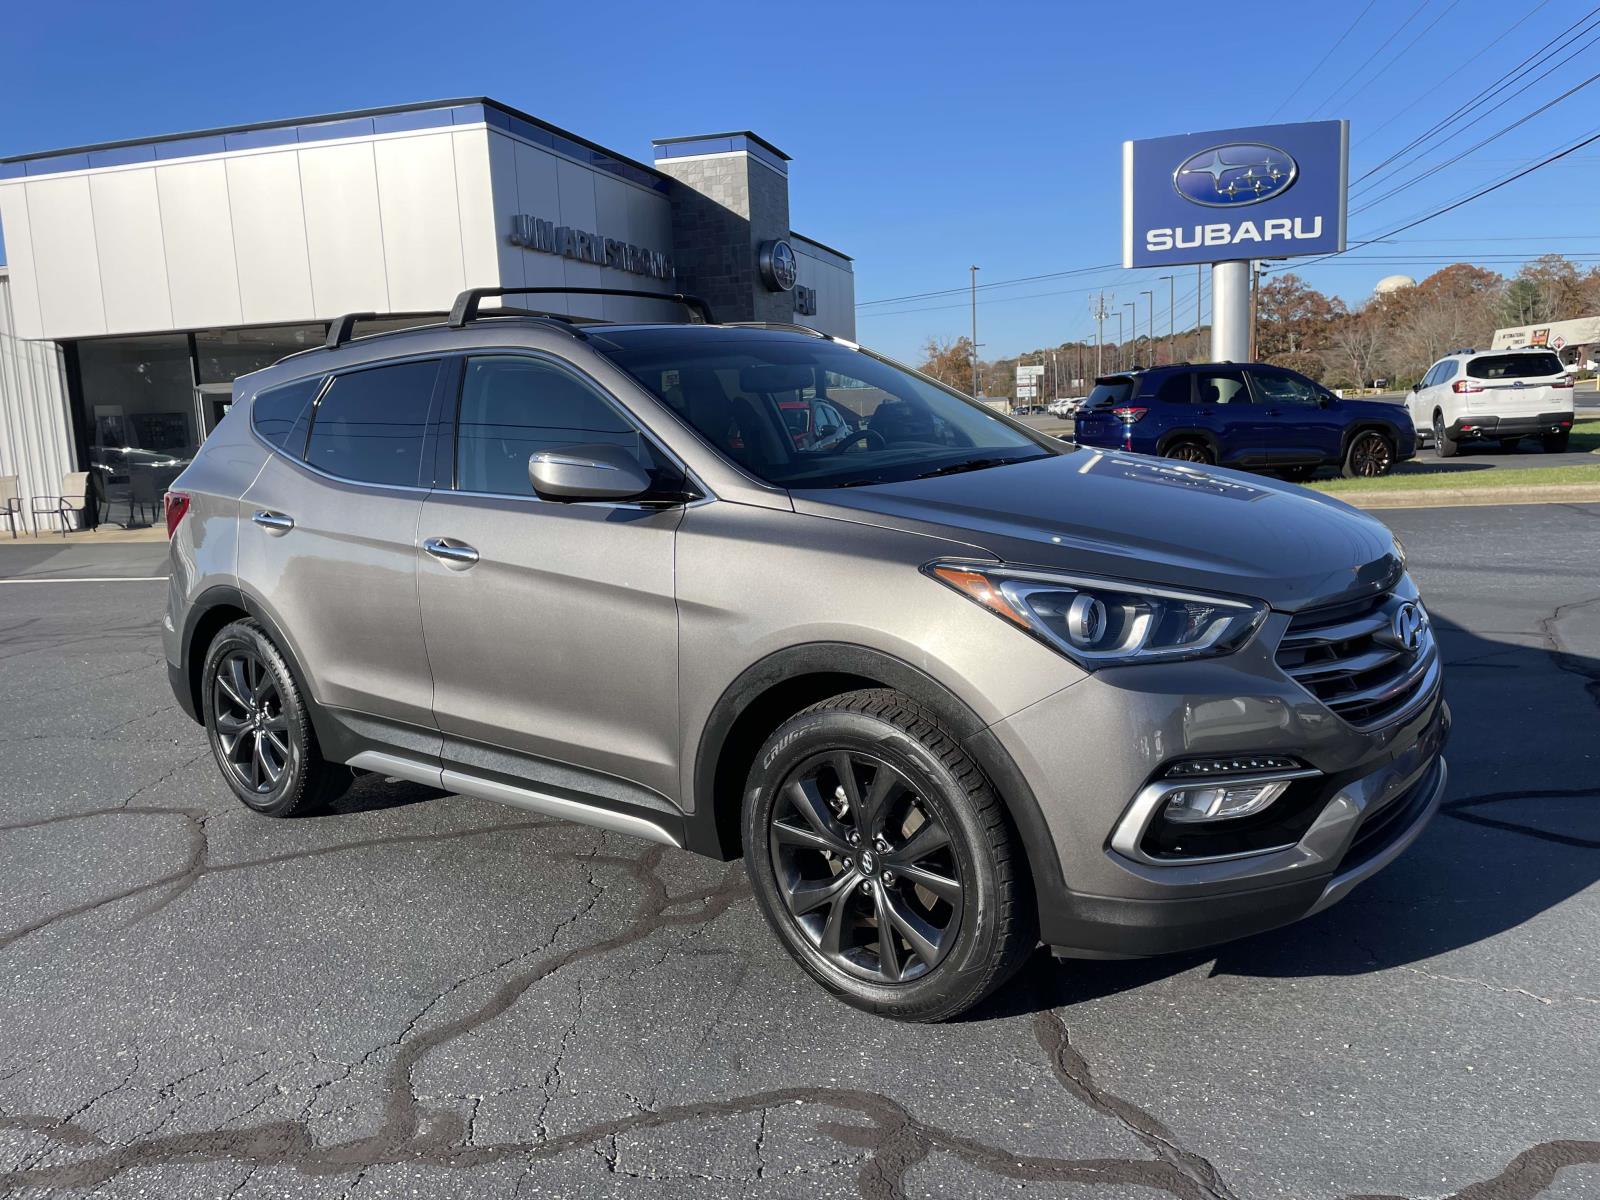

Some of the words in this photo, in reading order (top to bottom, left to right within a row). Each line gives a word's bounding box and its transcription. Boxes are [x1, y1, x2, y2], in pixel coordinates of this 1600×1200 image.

[508, 214, 556, 254] JIM
[556, 226, 676, 279] ARMSTRONG
[1146, 216, 1322, 251] SUBARU
